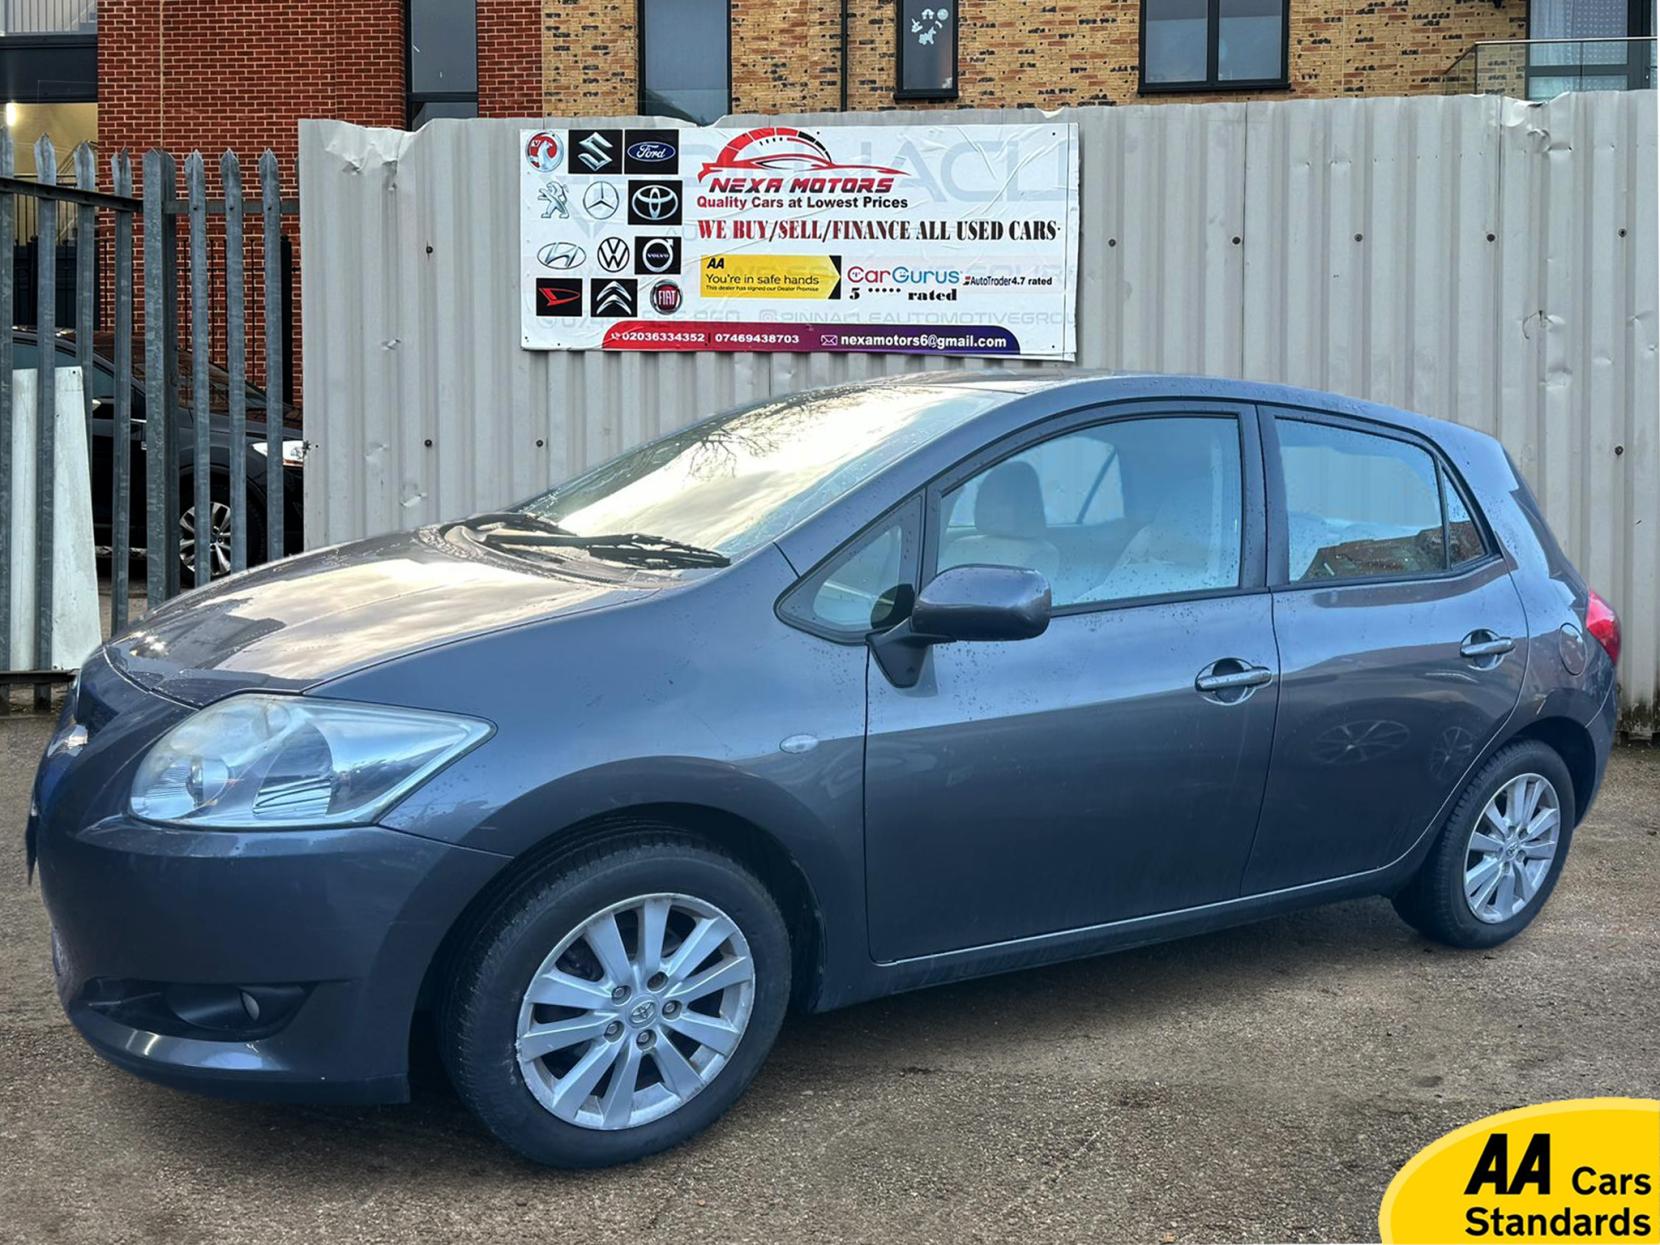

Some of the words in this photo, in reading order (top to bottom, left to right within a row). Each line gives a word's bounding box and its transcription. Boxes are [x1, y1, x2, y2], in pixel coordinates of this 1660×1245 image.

[636, 144, 666, 159] Ford
[709, 178, 784, 193] NEXA
[789, 178, 894, 193] MOTORS
[697, 197, 748, 210] Quality
[752, 197, 784, 208] Cars
[789, 197, 803, 208] at
[807, 197, 859, 208] Lowest
[863, 197, 908, 208] Prices
[698, 220, 727, 239] WE
[916, 221, 951, 240] ALL
[956, 221, 1004, 240] USED
[1009, 221, 1057, 240] CARS
[707, 257, 725, 269] AA
[706, 273, 741, 284] You're
[744, 273, 754, 284] in
[757, 274, 781, 285] safe
[784, 275, 820, 285] hands
[847, 266, 960, 284] CarGurus
[970, 275, 1011, 286] AutoTrader
[1011, 276, 1026, 286] 4.7
[1028, 276, 1053, 286] rated
[658, 290, 676, 305] FIAT
[849, 287, 860, 300] 5
[908, 288, 958, 300] rated
[622, 332, 705, 342] 02036334352
[715, 333, 800, 343] 07469438703
[841, 335, 1007, 349] nexamotors6@gmail.com
